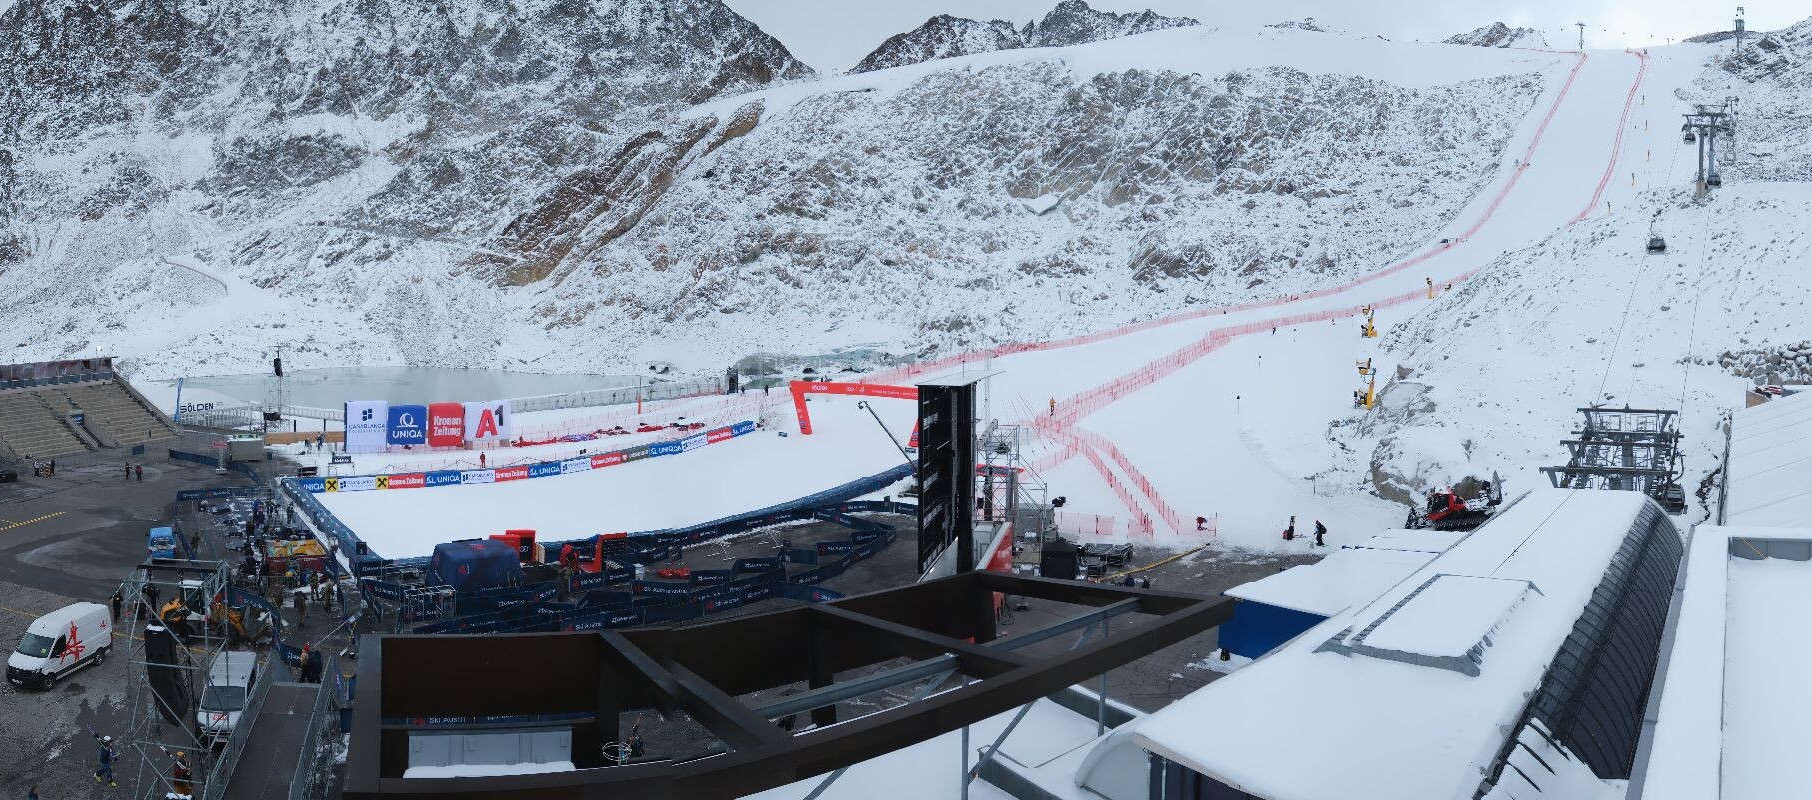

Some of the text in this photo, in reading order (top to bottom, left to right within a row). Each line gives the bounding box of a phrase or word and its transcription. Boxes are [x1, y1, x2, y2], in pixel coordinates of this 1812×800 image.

[180, 402, 214, 414] SÖLDEN
[433, 416, 462, 426] Kronen
[475, 405, 504, 438] A1
[392, 429, 423, 439] UNIQA
[433, 426, 461, 437] Zeitung
[539, 466, 560, 475] UNIQA
[437, 474, 461, 483] UNIQA
